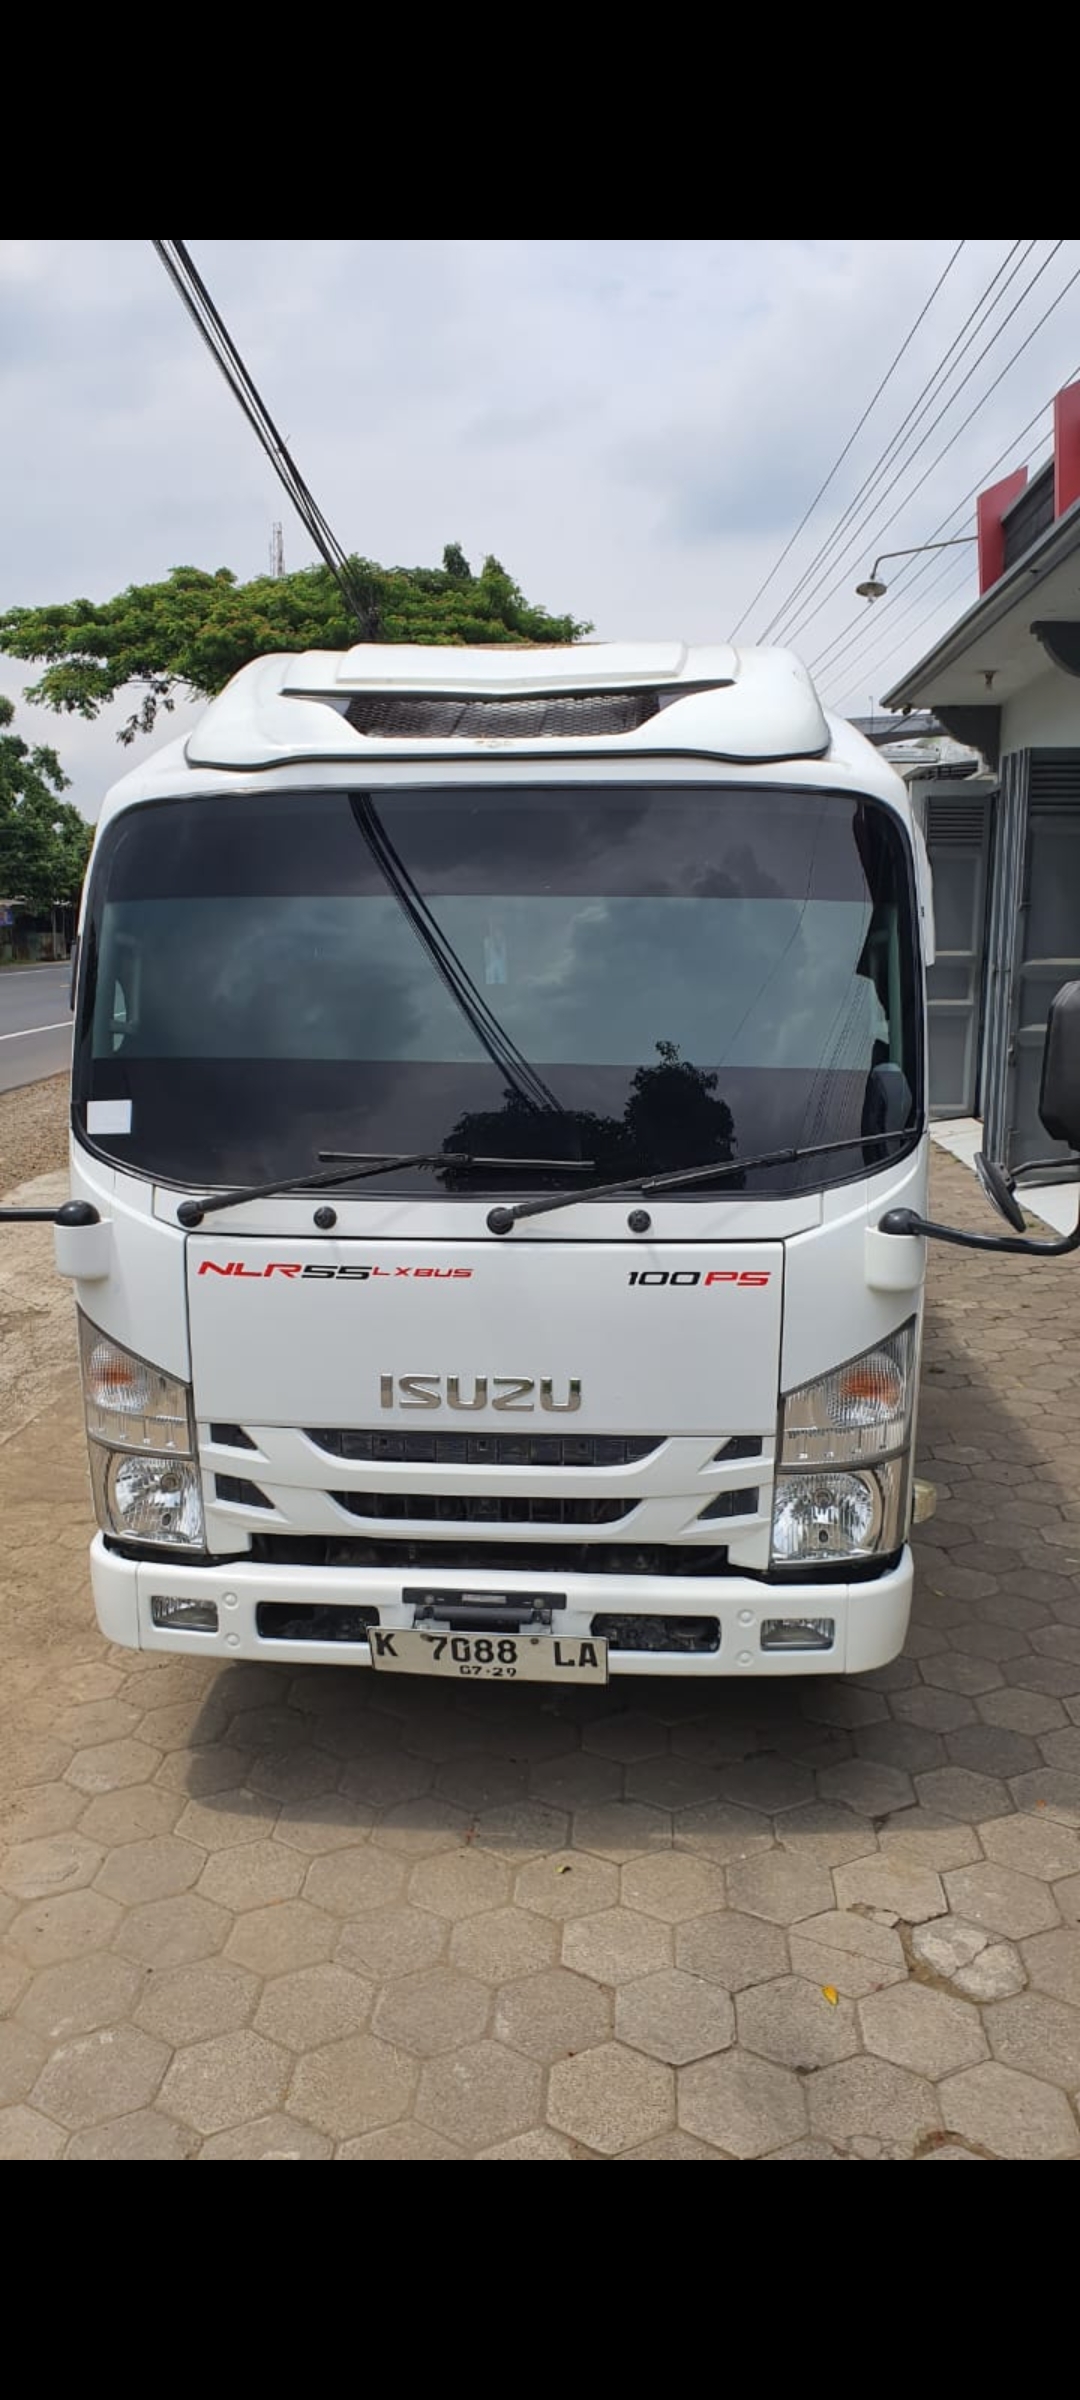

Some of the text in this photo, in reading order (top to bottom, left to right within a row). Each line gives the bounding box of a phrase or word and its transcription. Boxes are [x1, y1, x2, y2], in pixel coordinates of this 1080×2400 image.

[380, 1373, 581, 1412] ISUZU
[374, 1632, 598, 1667] K 7088 LA
